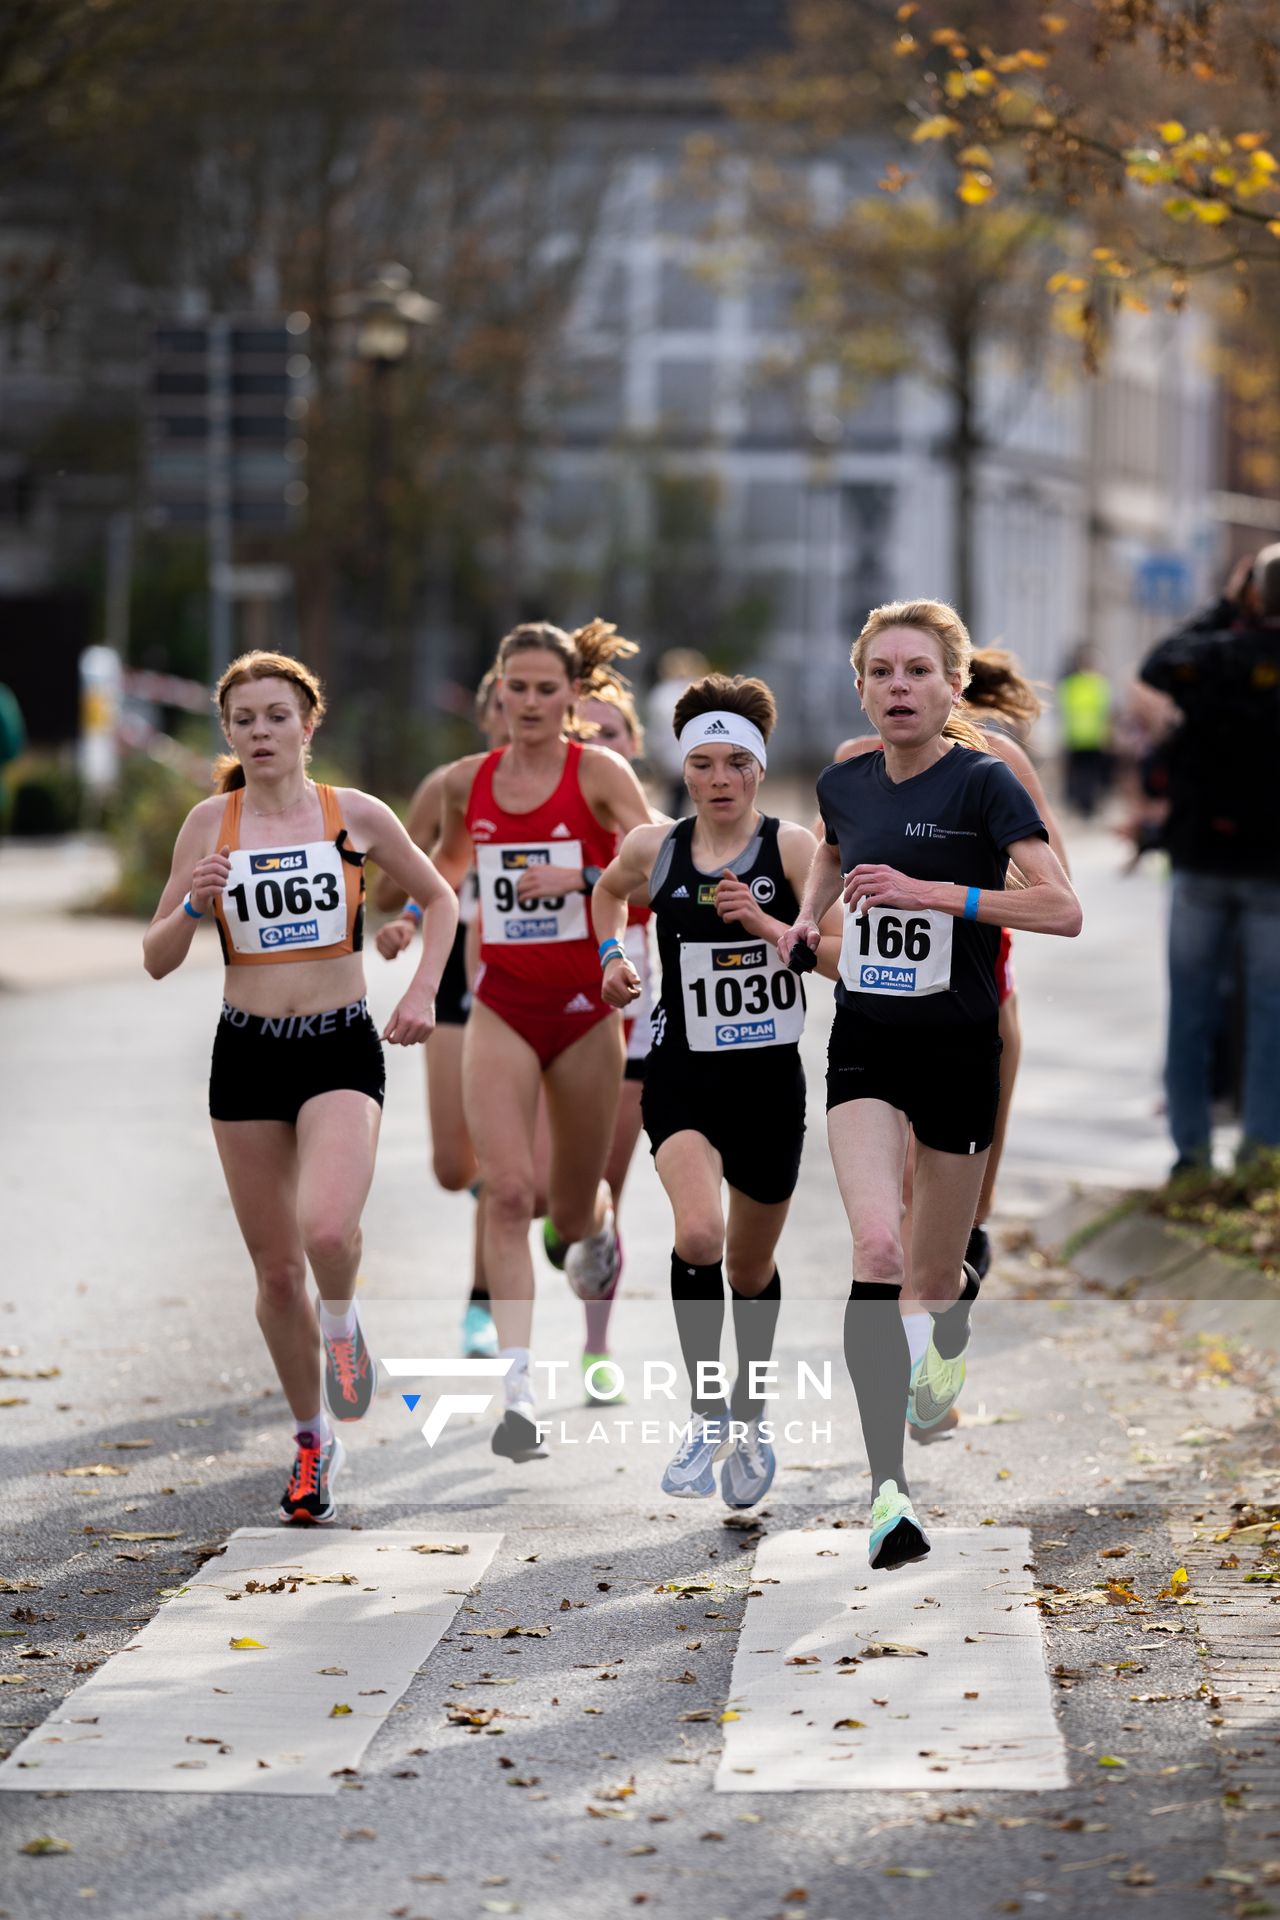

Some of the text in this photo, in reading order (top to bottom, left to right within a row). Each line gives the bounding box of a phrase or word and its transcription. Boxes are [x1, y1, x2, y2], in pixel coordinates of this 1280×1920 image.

[905, 822, 937, 838] MIT
[280, 855, 302, 869] GLS
[228, 873, 340, 922] 1063
[283, 923, 316, 938] PLAN
[855, 914, 931, 962] 166
[742, 951, 762, 966] GLS
[881, 970, 914, 983] PLAN
[689, 969, 796, 1018] 1030
[260, 1009, 338, 1039] NIKE
[740, 1023, 773, 1037] PLAN
